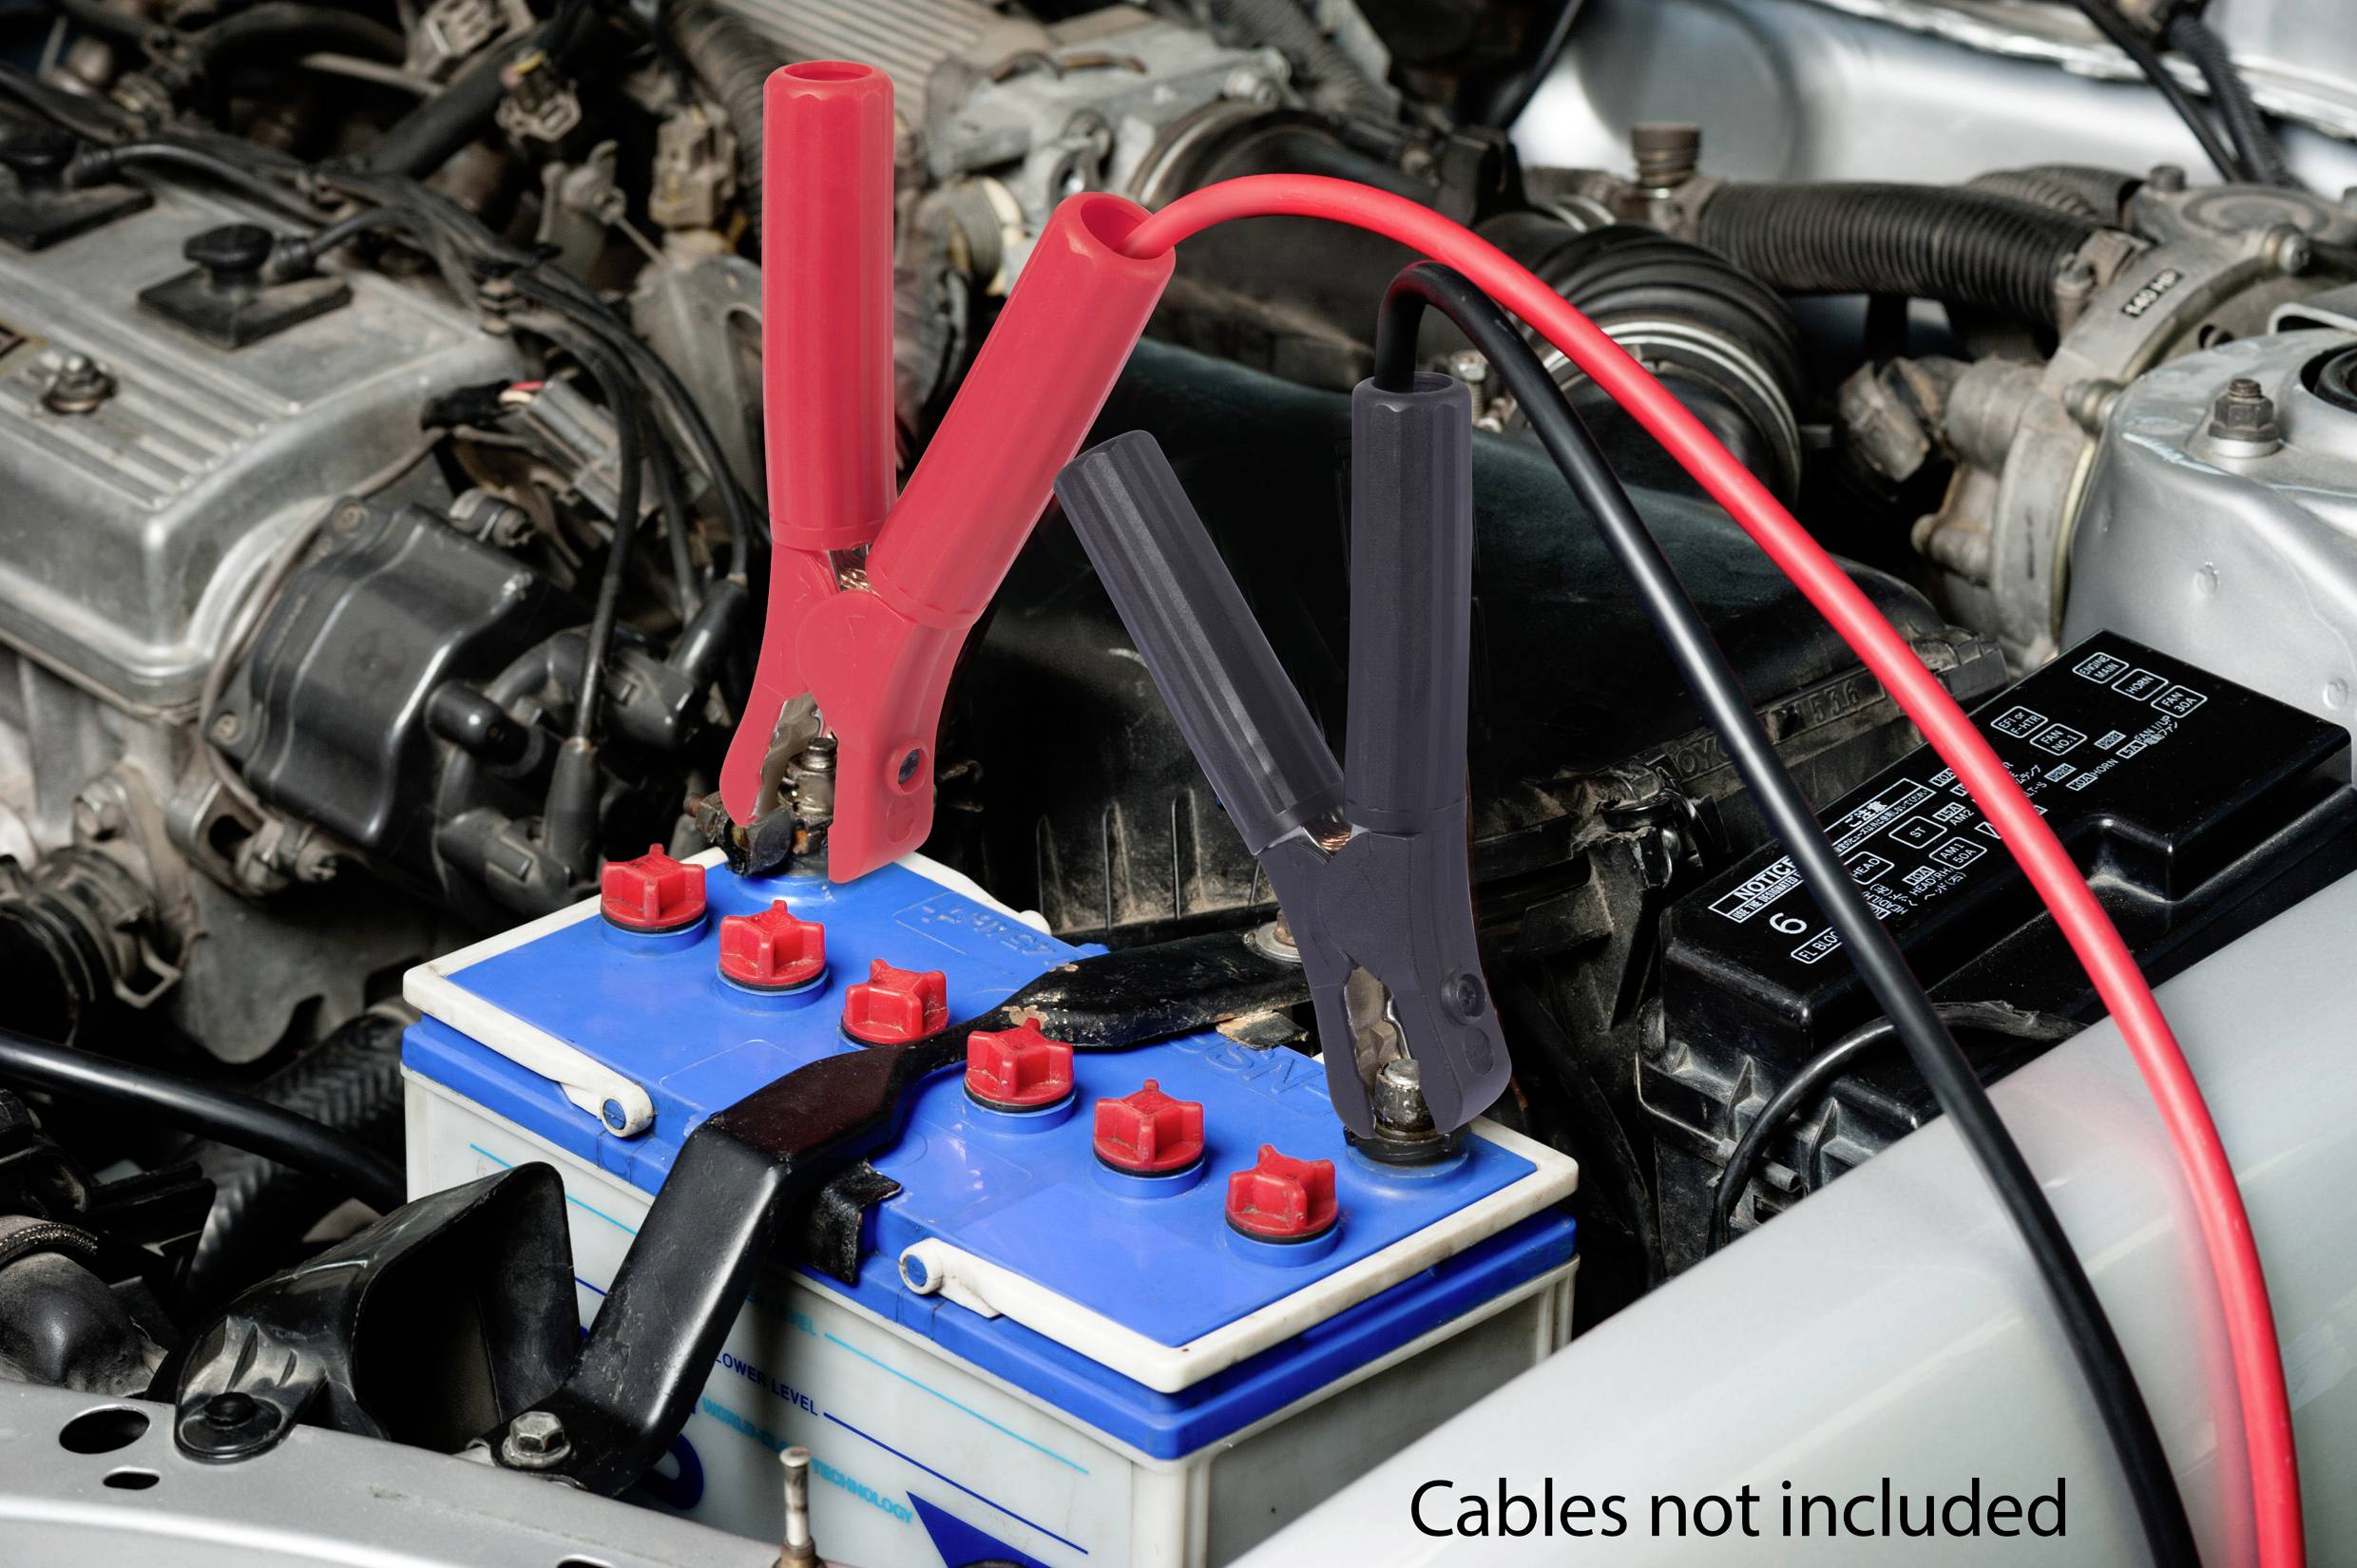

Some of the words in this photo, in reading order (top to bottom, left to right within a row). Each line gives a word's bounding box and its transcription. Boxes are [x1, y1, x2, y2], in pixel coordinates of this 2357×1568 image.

[2079, 654, 2110, 676] ENGINE
[2095, 662, 2119, 679] MAIN
[2125, 675, 2155, 695] HORN
[2161, 691, 2185, 707] FAN
[2174, 697, 2198, 714] 30A
[1998, 717, 2017, 730] EFI
[2014, 711, 2025, 720] or
[2010, 715, 2041, 735] F-HTR
[2041, 729, 2064, 744] FAN
[2051, 734, 2079, 752] NO.1
[2134, 728, 2156, 742] FAN
[2074, 773, 2093, 790] 10A
[2090, 758, 2119, 779] HORN
[1936, 803, 1962, 820] 15A
[1949, 808, 1975, 827] AM2
[1909, 826, 1927, 838] ST
[1940, 842, 1965, 860] AM1
[1952, 848, 1978, 865] 50A
[1850, 857, 1881, 879] HEAD
[1907, 867, 1932, 884] 10A
[1757, 875, 1799, 905] DESIGNATED
[1768, 912, 1809, 935] 6
[1797, 949, 1819, 961] FL
[772, 1380, 819, 1417] LEVEL
[812, 1454, 913, 1524] TECHNOLOGY
